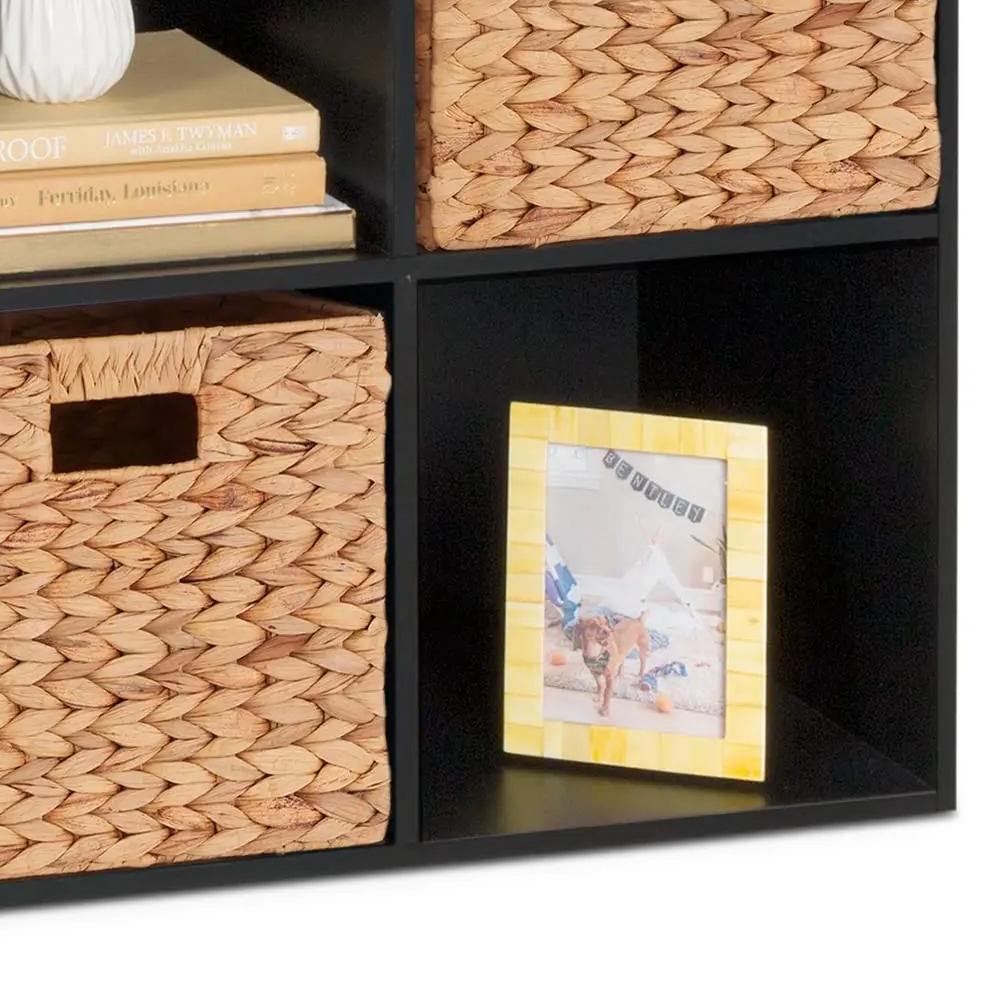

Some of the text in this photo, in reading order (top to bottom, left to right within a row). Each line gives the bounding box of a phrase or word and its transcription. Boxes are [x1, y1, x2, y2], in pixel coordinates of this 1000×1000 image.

[104, 127, 156, 148] JAMES
[177, 122, 258, 142] TWYMAN
[605, 452, 703, 522] BENTLEY
